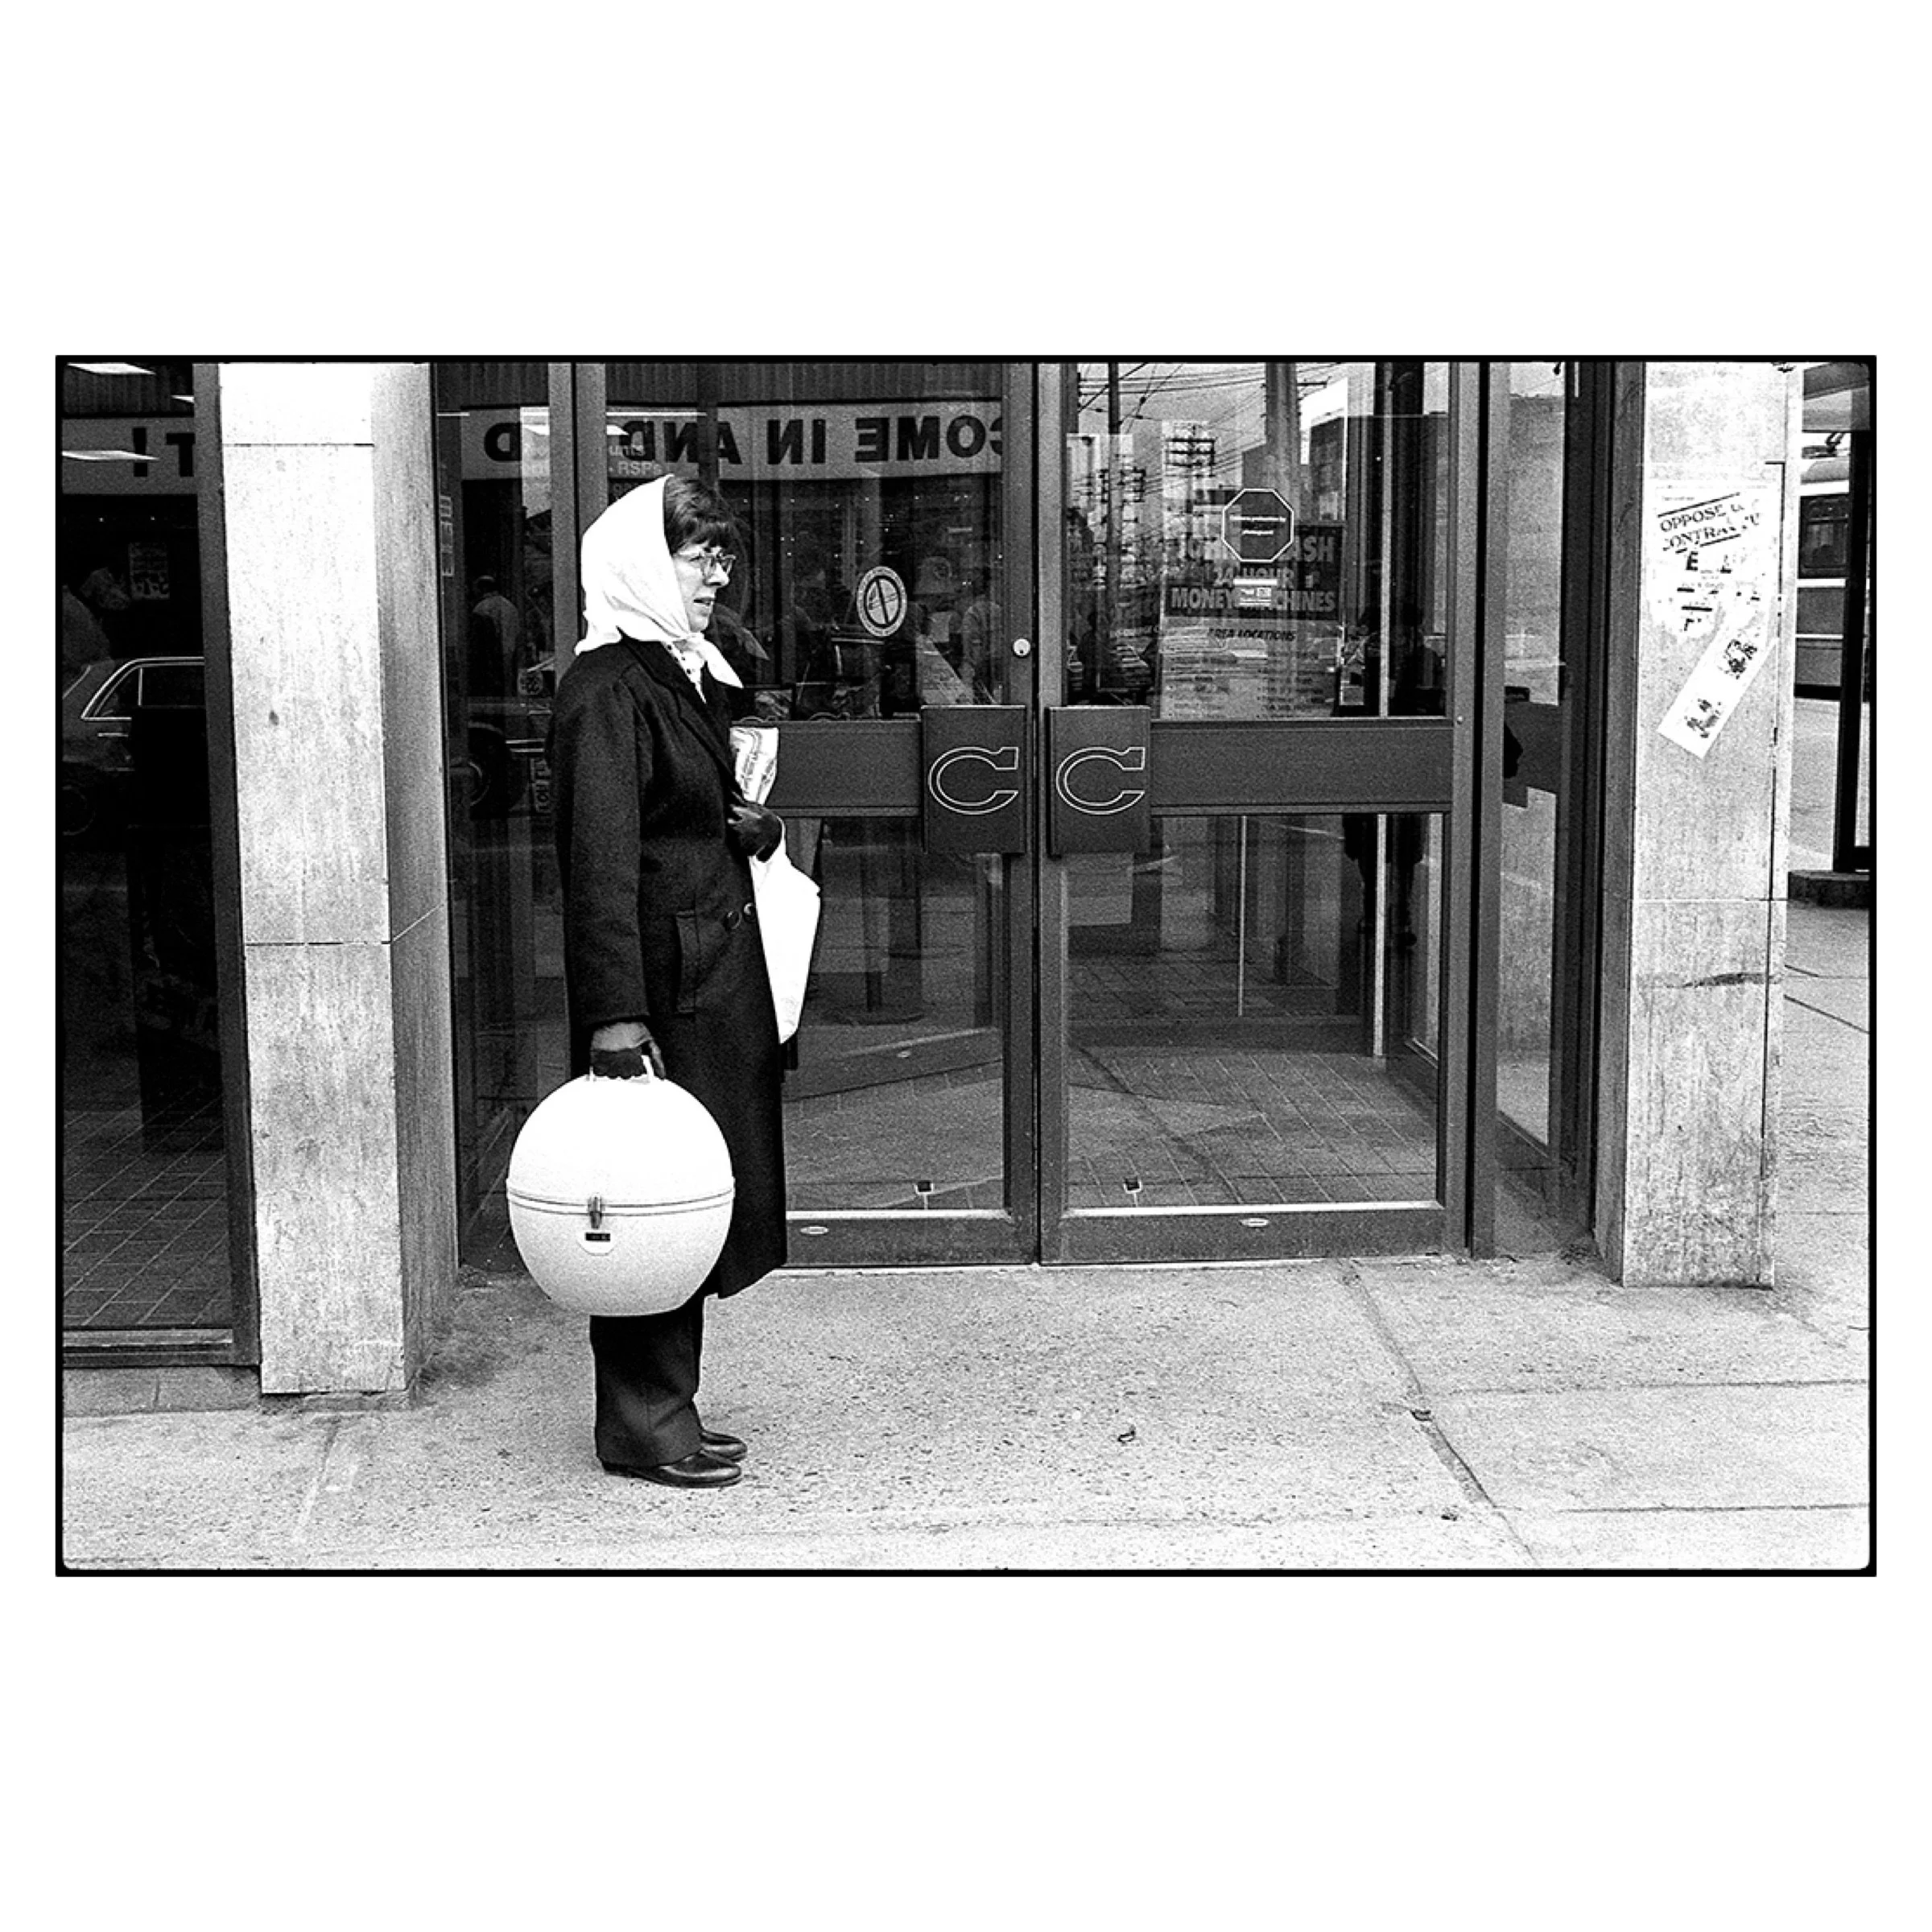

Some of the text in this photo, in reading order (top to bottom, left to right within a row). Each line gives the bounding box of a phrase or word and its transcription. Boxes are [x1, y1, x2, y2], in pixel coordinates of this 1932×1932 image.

[1277, 535, 1335, 563] ASH
[1241, 589, 1336, 612] CHINES
[929, 746, 1019, 815] C
[1055, 746, 1146, 815] C
